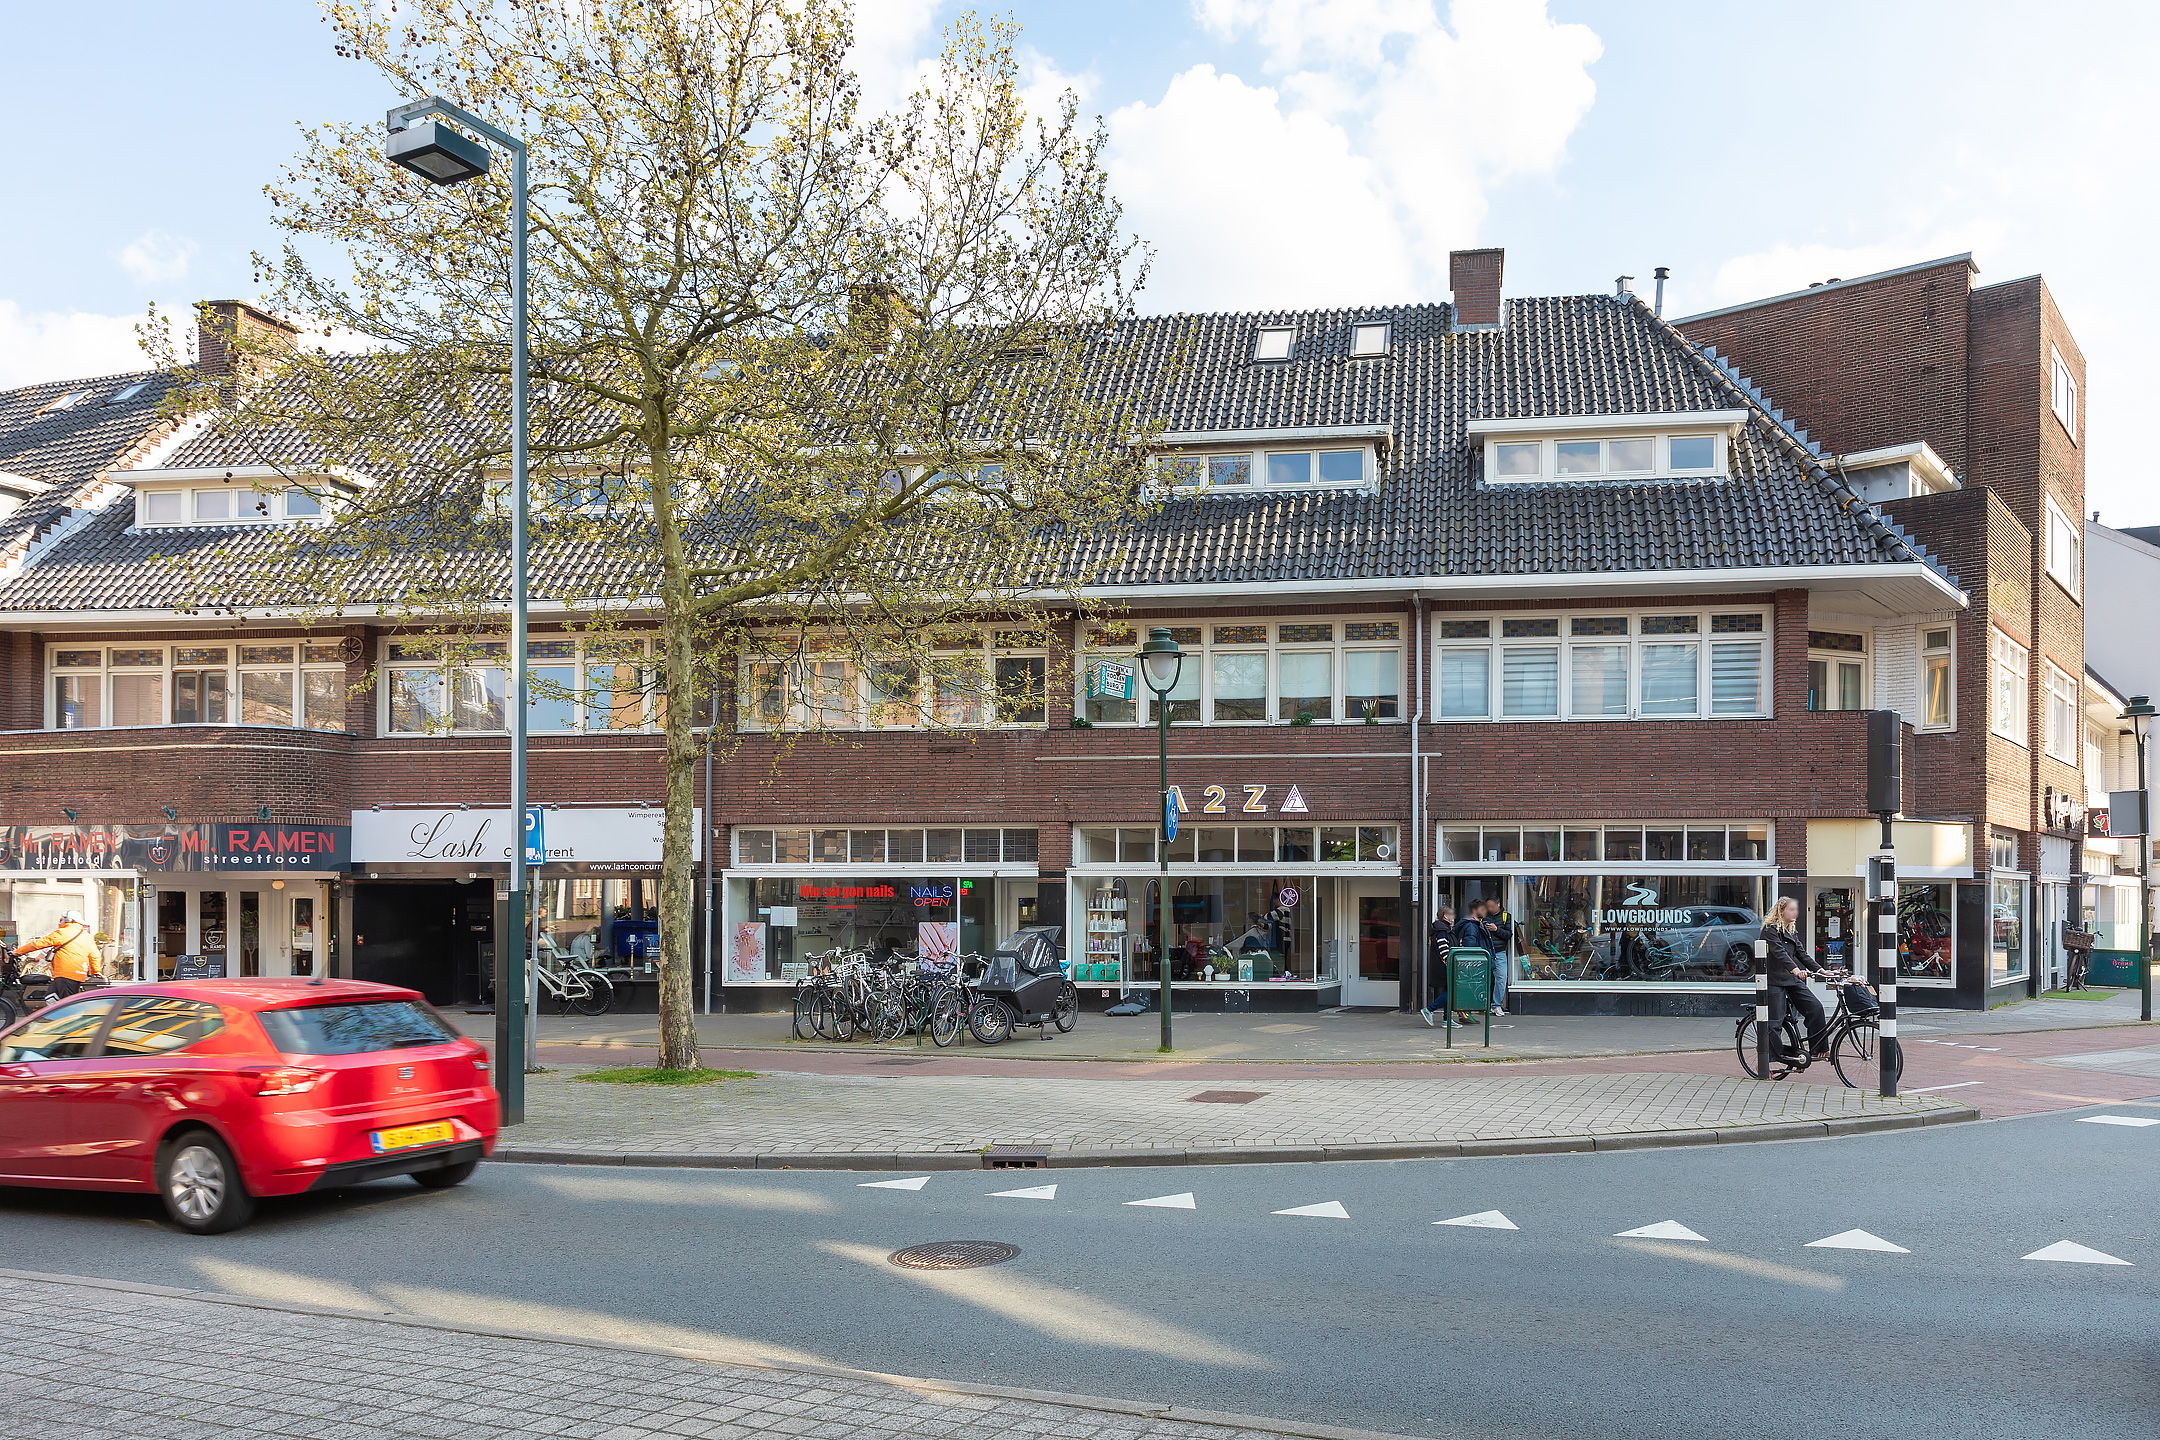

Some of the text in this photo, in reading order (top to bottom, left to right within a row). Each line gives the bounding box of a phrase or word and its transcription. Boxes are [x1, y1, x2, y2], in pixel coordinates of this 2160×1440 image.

[20, 832, 117, 853] Mr. RAMEN
[182, 830, 335, 853] Mr. RAMEN
[406, 812, 491, 859] Lash
[203, 854, 311, 864] streetfood
[823, 885, 841, 897] sai
[842, 886, 864, 898] gon
[866, 885, 895, 897] nails
[910, 885, 953, 898] NAILS
[913, 897, 950, 907] OPEN
[1591, 909, 1692, 924] FLOWGROUNDS
